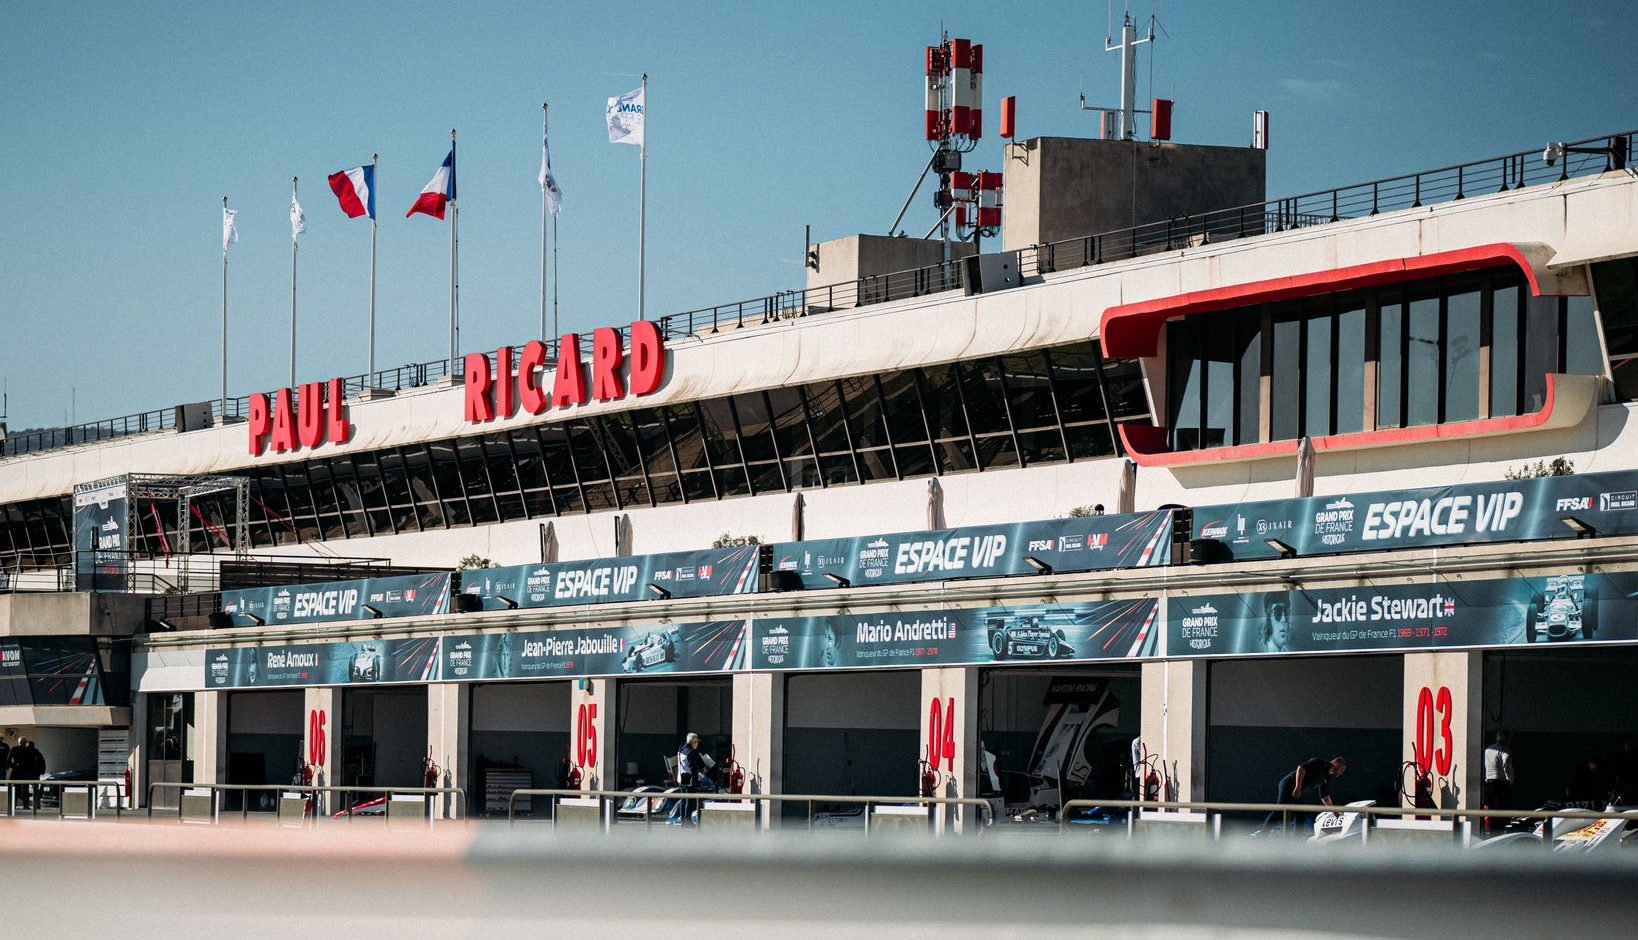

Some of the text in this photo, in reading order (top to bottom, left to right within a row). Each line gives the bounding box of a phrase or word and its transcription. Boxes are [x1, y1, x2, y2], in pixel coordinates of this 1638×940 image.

[249, 320, 665, 456] PAUL RICARD
[1556, 496, 1590, 511] FFSA
[1315, 509, 1354, 523] GRAND PRIX
[1361, 491, 1524, 541] ESPACE VIP
[1315, 520, 1353, 534] DE FRANCE
[860, 548, 889, 559] GRAND PRIX
[894, 534, 1007, 574] ESPACE VIP
[1028, 539, 1052, 552] FFSA
[859, 557, 889, 568] DE FRANCE
[554, 565, 638, 599] ESPACE VIP
[654, 570, 672, 580] FFSA
[293, 591, 338, 617] ESPACE
[338, 588, 358, 614] VIP
[1312, 594, 1443, 623] Jackie Stewart
[856, 616, 947, 643] Mario Andretti
[1182, 616, 1218, 627] GRAND PRIX
[1182, 626, 1218, 638] DE FRANCE
[1312, 632, 1342, 642] Vainqueur
[1342, 631, 1350, 640] du
[1350, 630, 1359, 640] GP
[1359, 630, 1367, 639] de
[1367, 628, 1388, 639] France
[1389, 628, 1396, 638] F1
[1415, 627, 1430, 637] 1971
[521, 633, 618, 657] Jean-Pierre Jabouille
[762, 636, 778, 646] GRAND
[762, 644, 789, 655] DE FRANCE
[2, 650, 20, 661] AVON
[267, 649, 314, 668] René Arnoux
[310, 709, 326, 767] 06
[577, 703, 597, 768] 05
[929, 697, 955, 771] 04
[1416, 686, 1453, 777] 03
